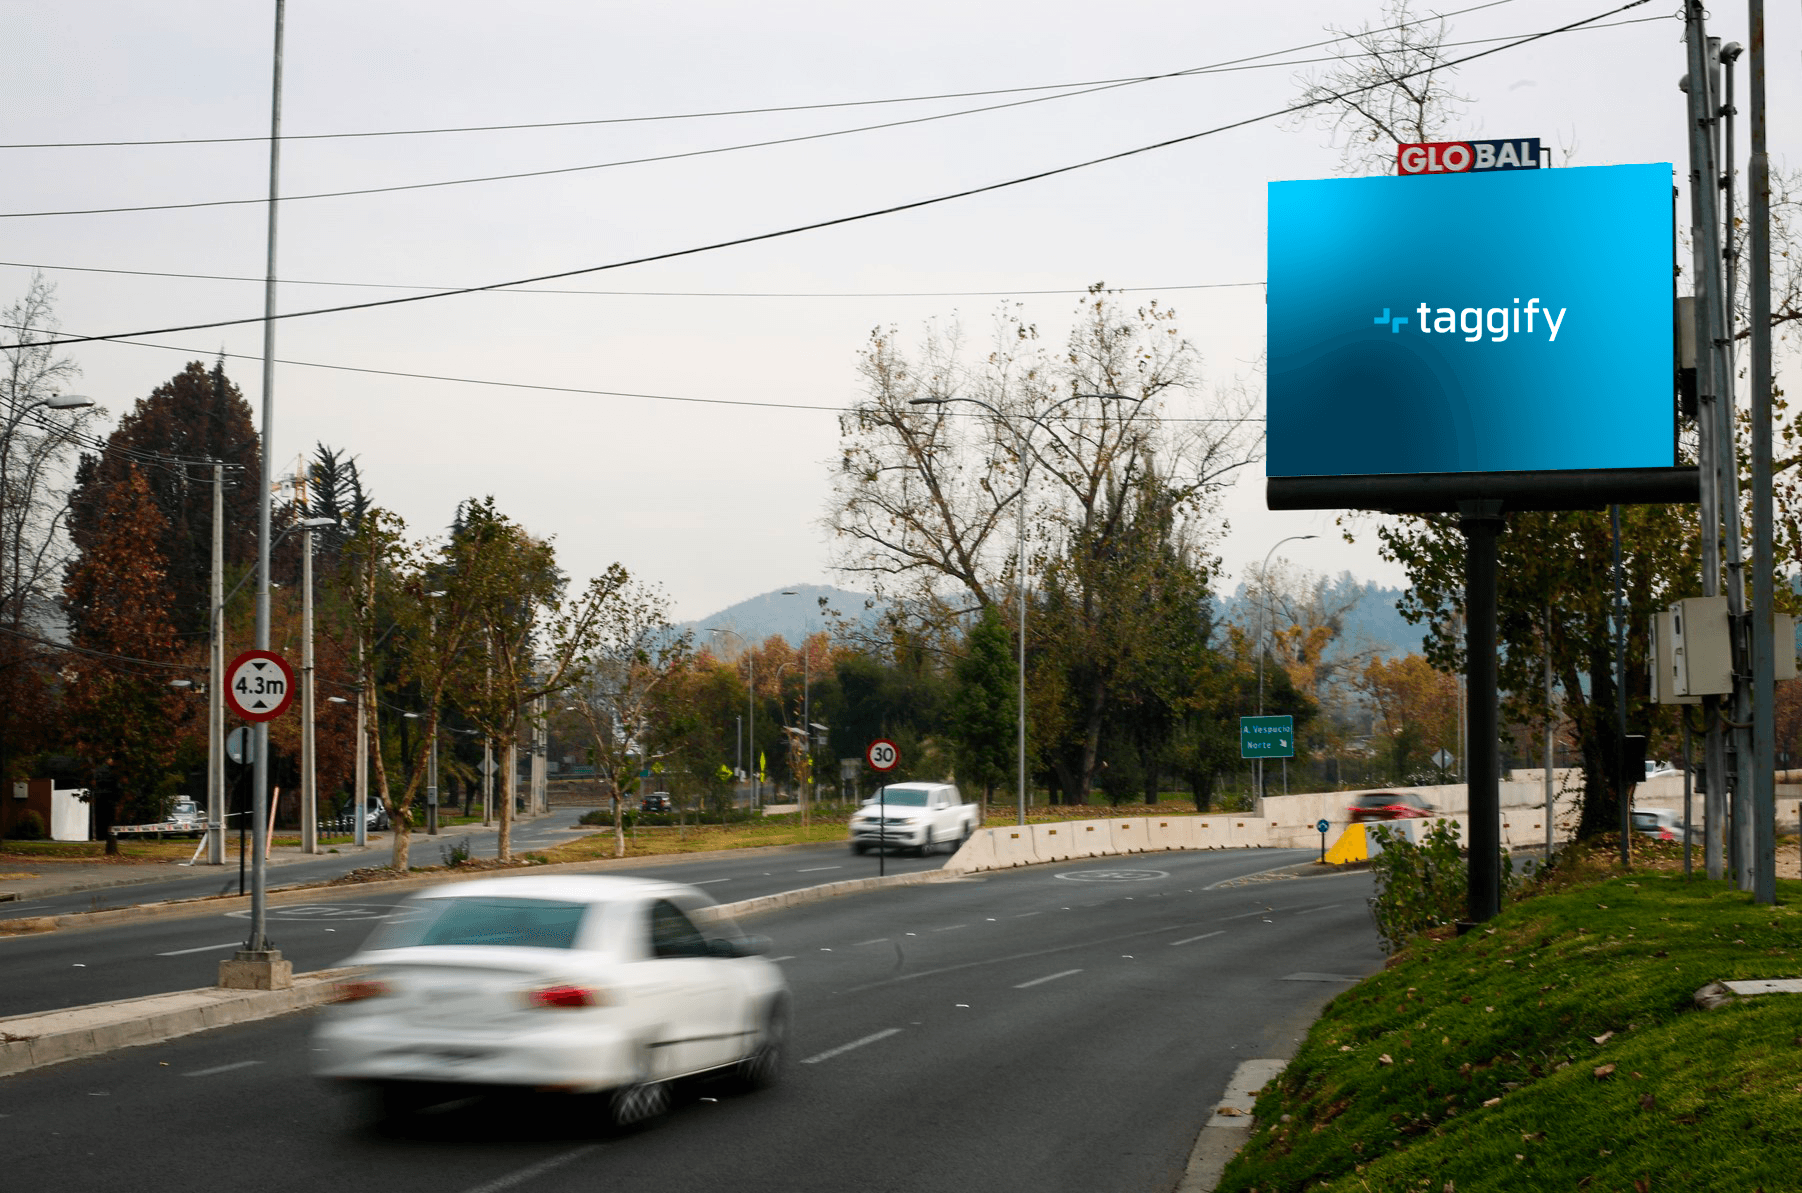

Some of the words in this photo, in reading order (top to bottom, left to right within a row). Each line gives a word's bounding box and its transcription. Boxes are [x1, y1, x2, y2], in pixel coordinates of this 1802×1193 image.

[1401, 142, 1538, 173] GLOBAL
[1416, 298, 1567, 342] taggify
[236, 676, 284, 695] 4.3m
[1252, 725, 1291, 735] Vespucio
[1247, 741, 1271, 749] Norte
[874, 747, 894, 762] 30
